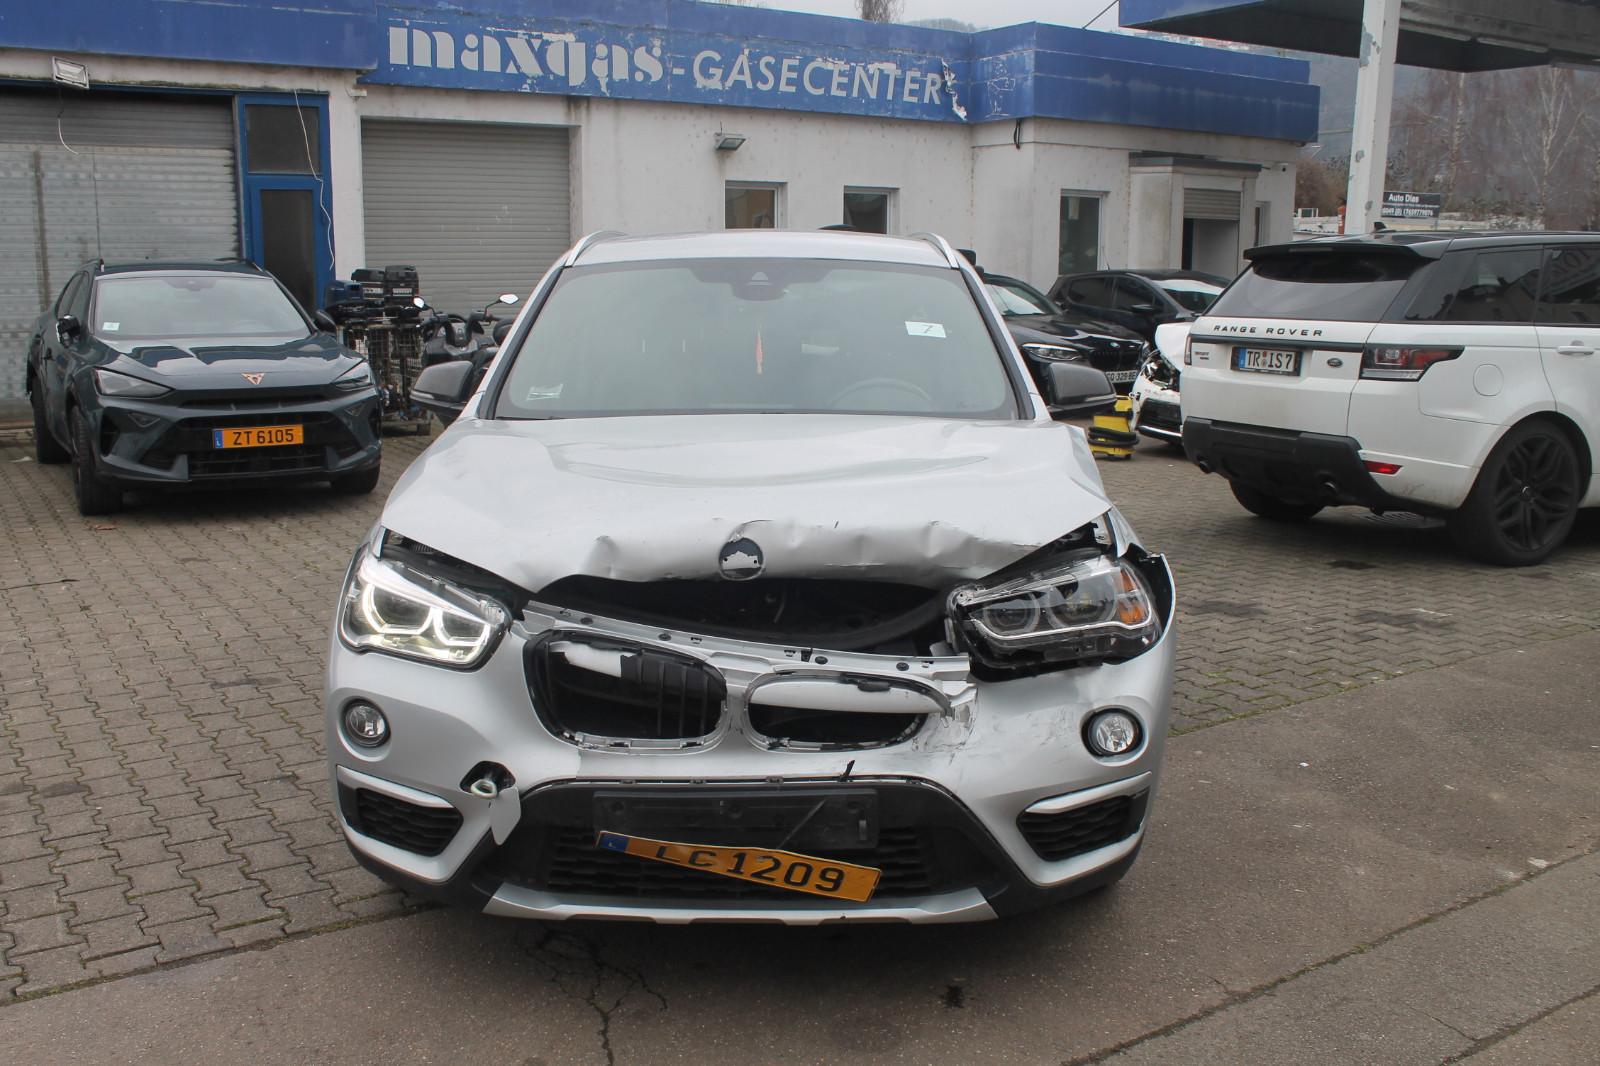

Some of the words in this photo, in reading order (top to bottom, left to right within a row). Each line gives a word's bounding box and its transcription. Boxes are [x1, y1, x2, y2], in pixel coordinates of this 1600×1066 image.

[1388, 193, 1404, 202] Auto
[1214, 325, 1257, 333] RANGE
[1266, 327, 1323, 336] ROVER
[1247, 351, 1260, 367] TR
[232, 431, 252, 446] ZT
[257, 428, 294, 444] 6105
[727, 851, 845, 892] 1209
